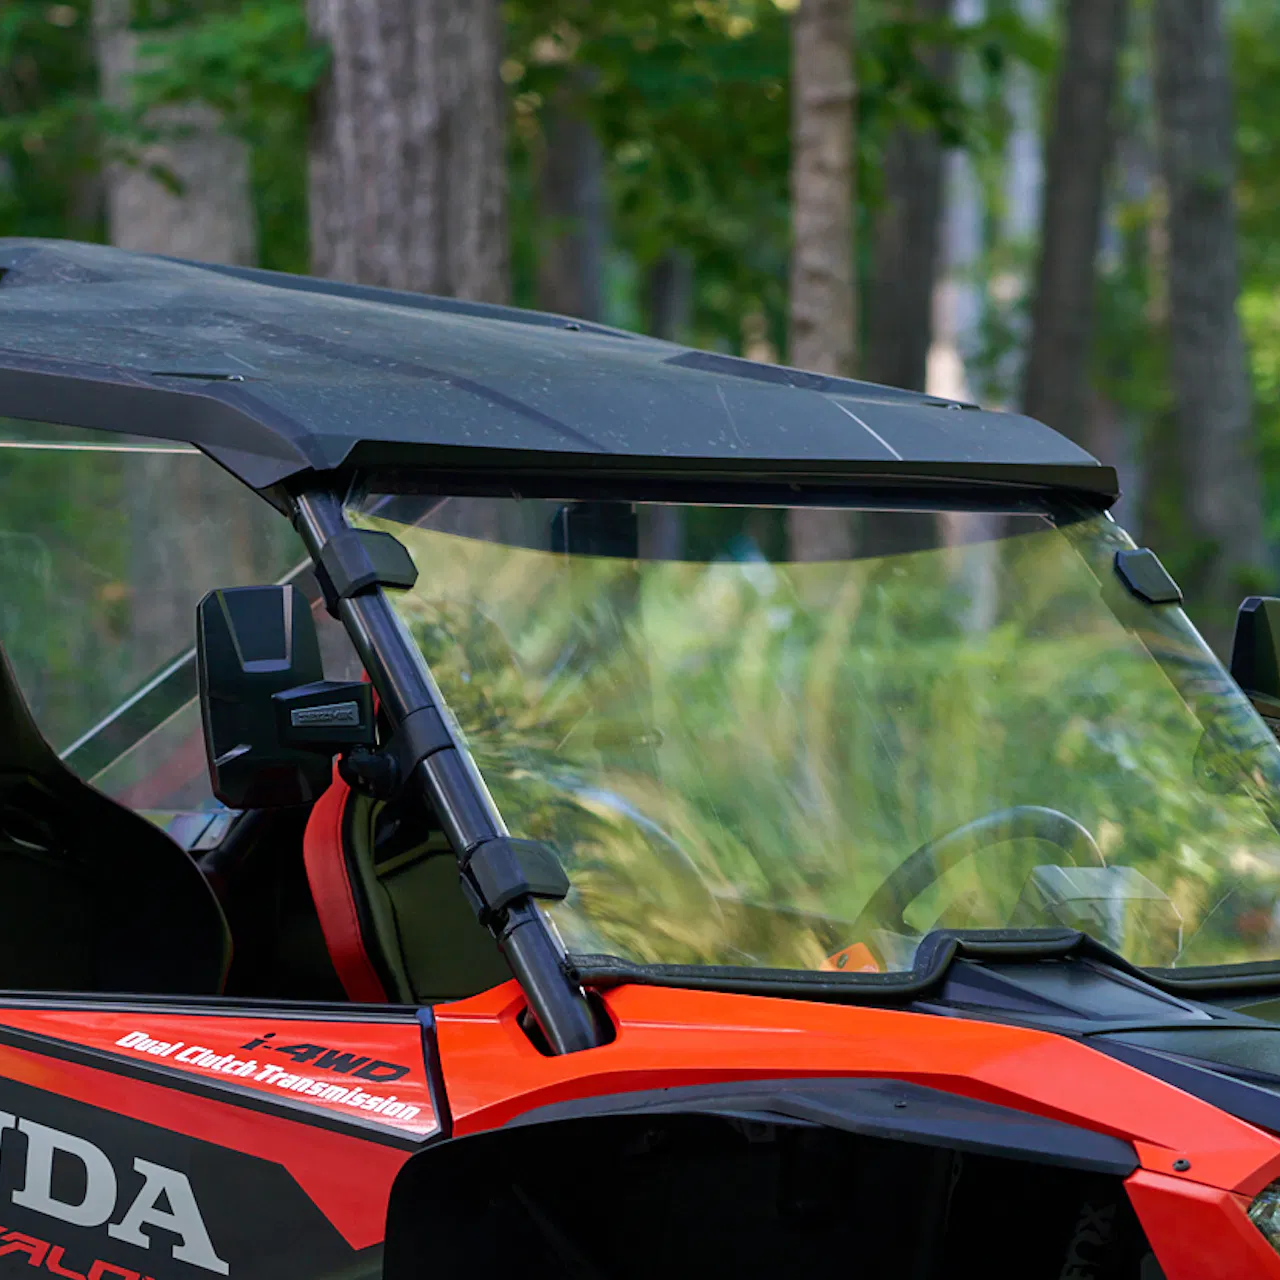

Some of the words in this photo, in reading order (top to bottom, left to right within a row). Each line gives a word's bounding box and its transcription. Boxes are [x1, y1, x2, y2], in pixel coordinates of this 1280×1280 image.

[115, 1031, 185, 1058] Dual
[174, 1045, 258, 1078] Clutch
[252, 1063, 421, 1121] Transmission
[240, 1032, 411, 1083] i-4WD
